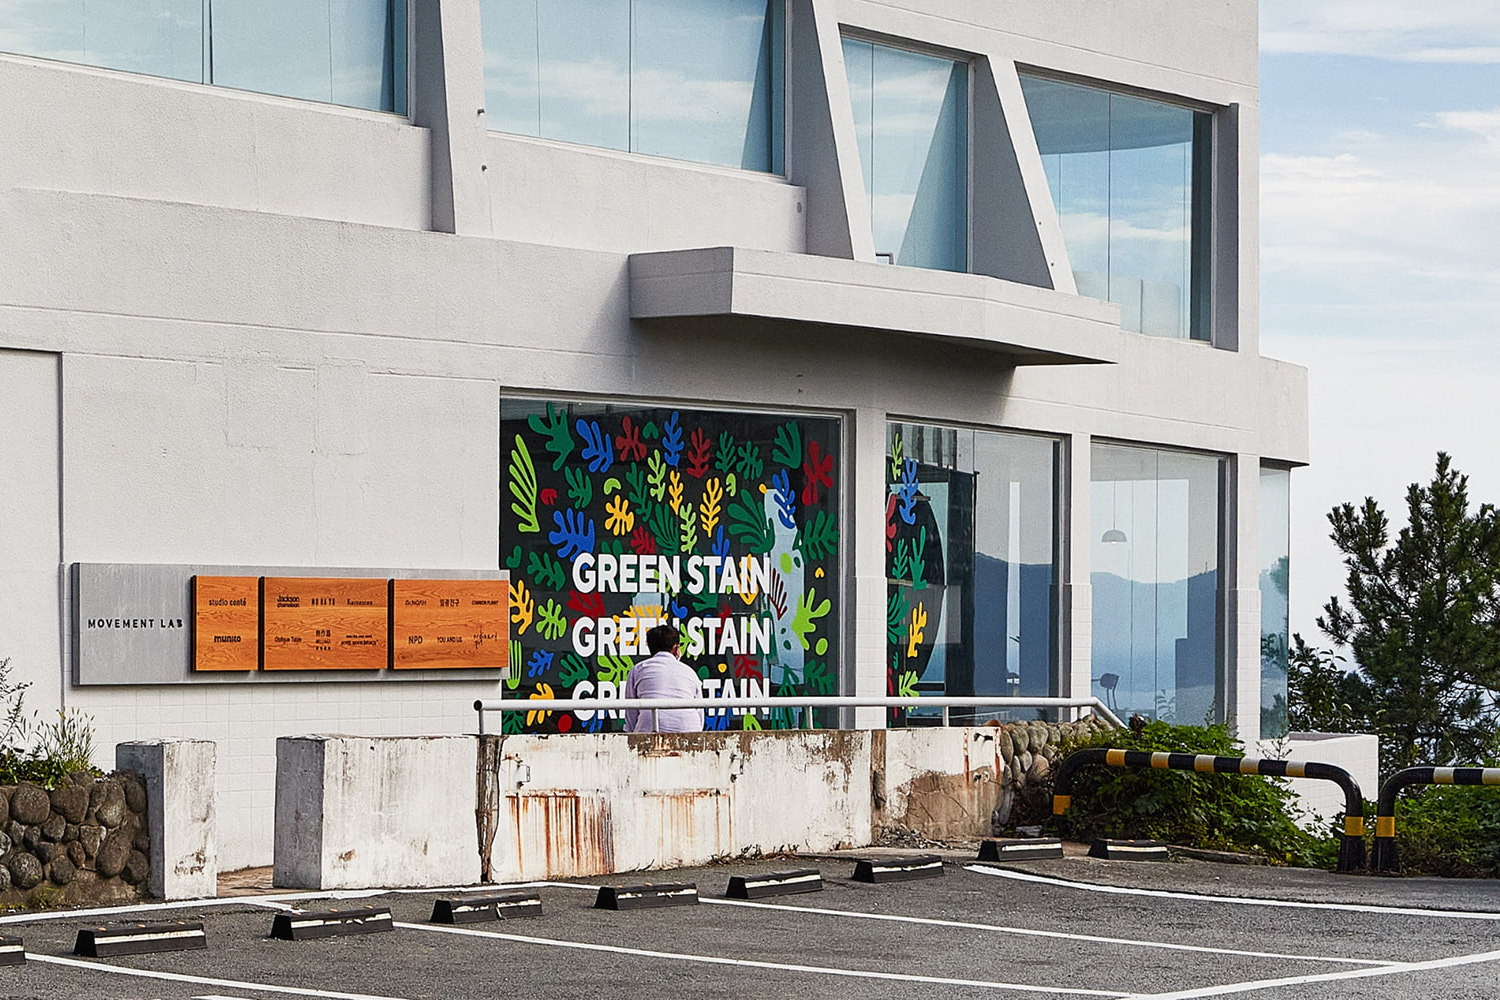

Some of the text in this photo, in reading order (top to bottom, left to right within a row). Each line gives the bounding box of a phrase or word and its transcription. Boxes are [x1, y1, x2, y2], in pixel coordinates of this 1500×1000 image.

[572, 552, 771, 595] GREEN STAIN
[87, 618, 183, 629] MOVEMENT LAB
[408, 635, 423, 645] NPD
[572, 616, 771, 658] GREE STAIN
[700, 678, 770, 716] TAIN
